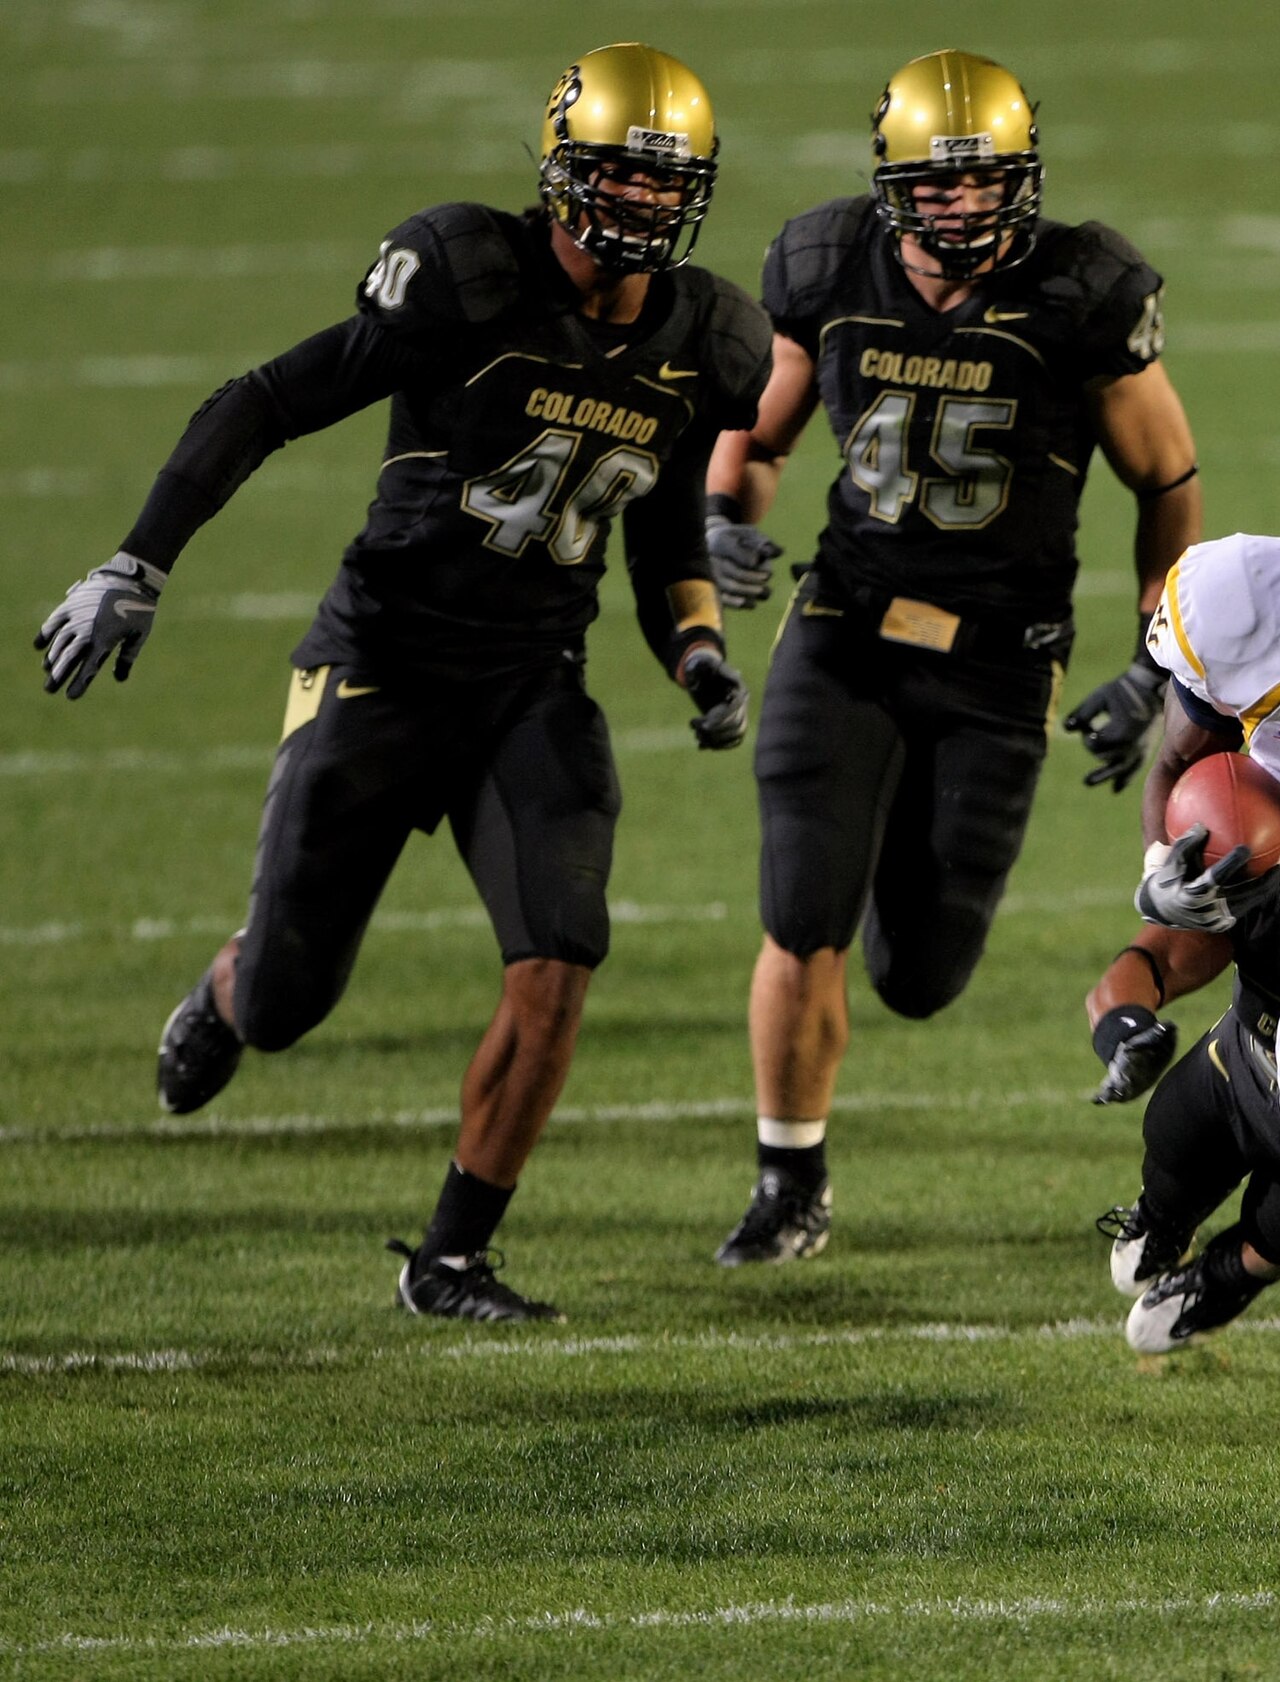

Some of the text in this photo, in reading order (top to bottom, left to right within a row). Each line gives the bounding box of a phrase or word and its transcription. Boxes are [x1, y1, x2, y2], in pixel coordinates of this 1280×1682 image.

[525, 387, 658, 445] COLORADO
[859, 348, 993, 392] COLORADO
[460, 428, 659, 565] 40
[843, 389, 1018, 530] 45
